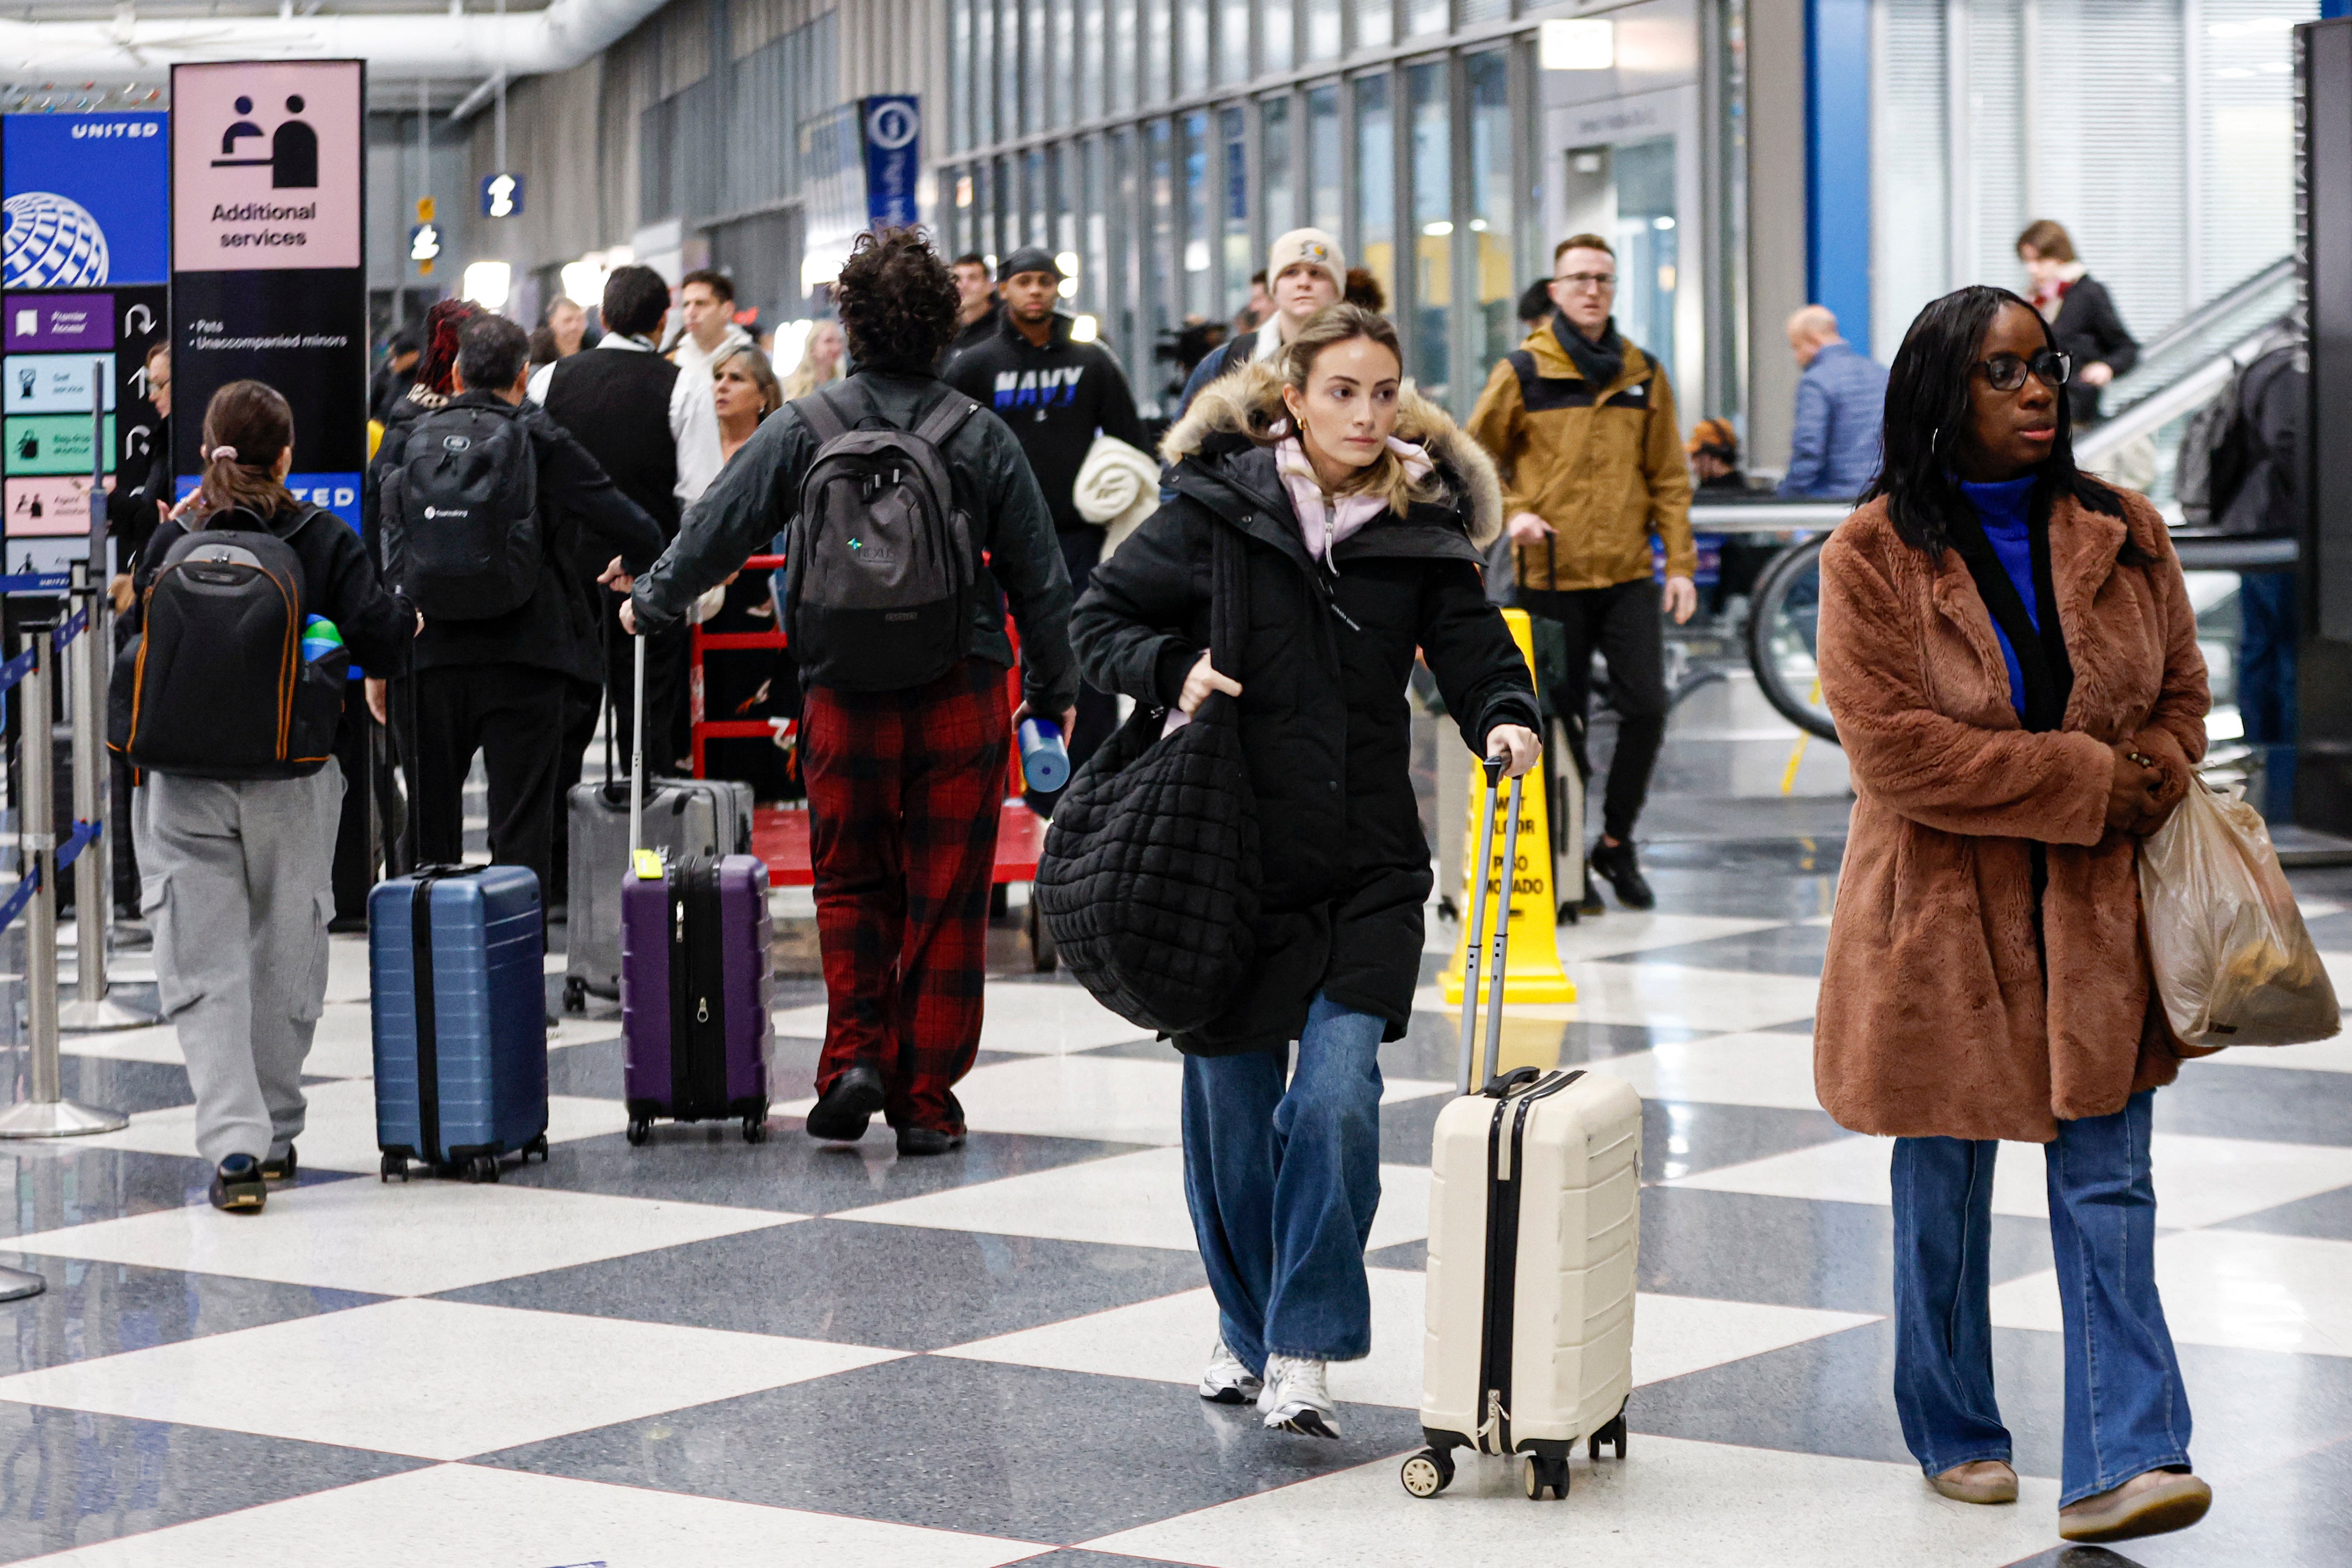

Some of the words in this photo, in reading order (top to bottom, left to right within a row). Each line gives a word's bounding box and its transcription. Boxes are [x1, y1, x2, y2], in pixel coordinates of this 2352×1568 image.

[72, 122, 159, 139] UNITED
[211, 202, 316, 222] Additional
[221, 228, 307, 247] services
[195, 333, 301, 351] Unaccompanied
[302, 333, 348, 348] minors
[994, 365, 1086, 408] NAVY
